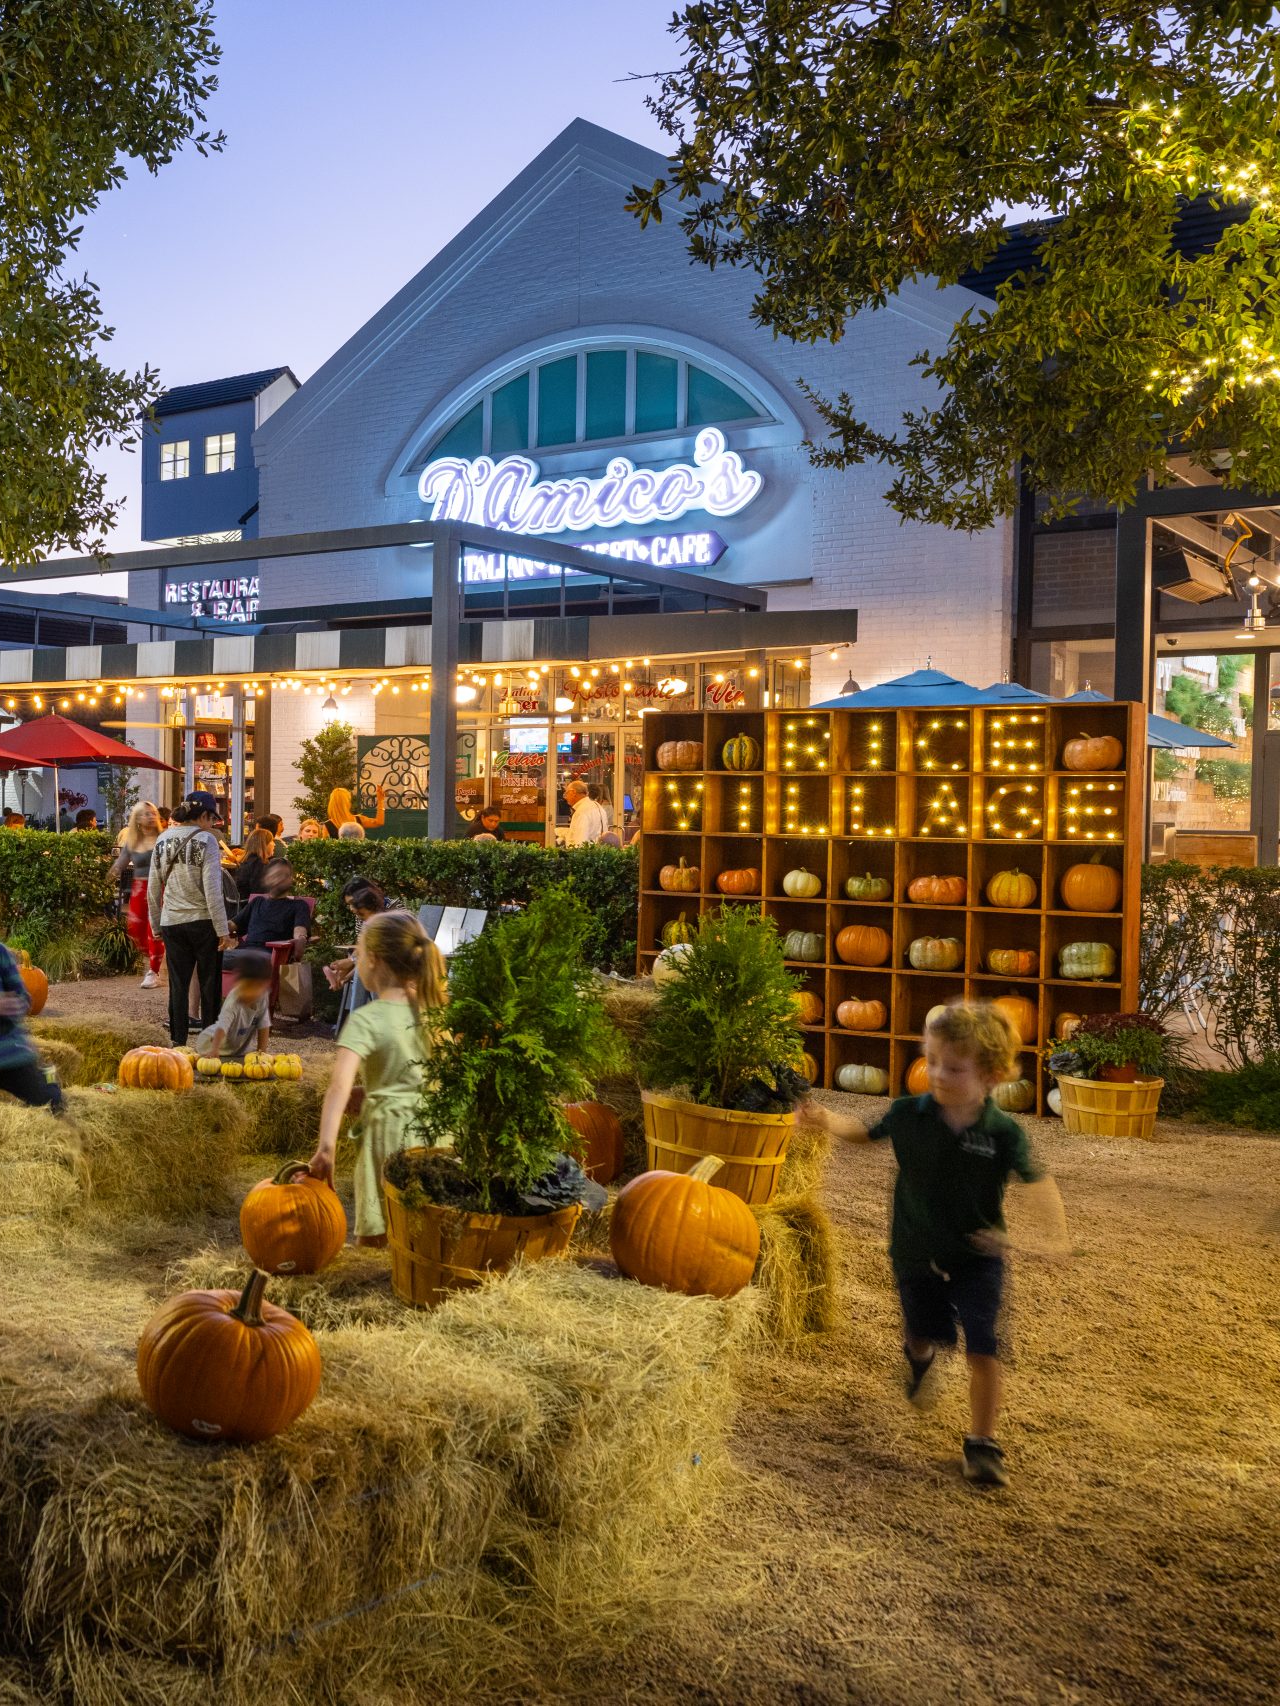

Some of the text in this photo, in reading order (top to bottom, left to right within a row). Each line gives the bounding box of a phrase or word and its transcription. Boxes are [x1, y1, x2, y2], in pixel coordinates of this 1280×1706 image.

[420, 429, 761, 534] D'Amico's
[651, 533, 711, 567] CAFE
[165, 576, 260, 603] RESTAURA
[500, 686, 541, 697] Ialian
[563, 679, 678, 702] Ristoante
[784, 715, 1044, 771] RICE
[495, 750, 545, 772] Gelato
[664, 780, 1124, 839] VILLAGE
